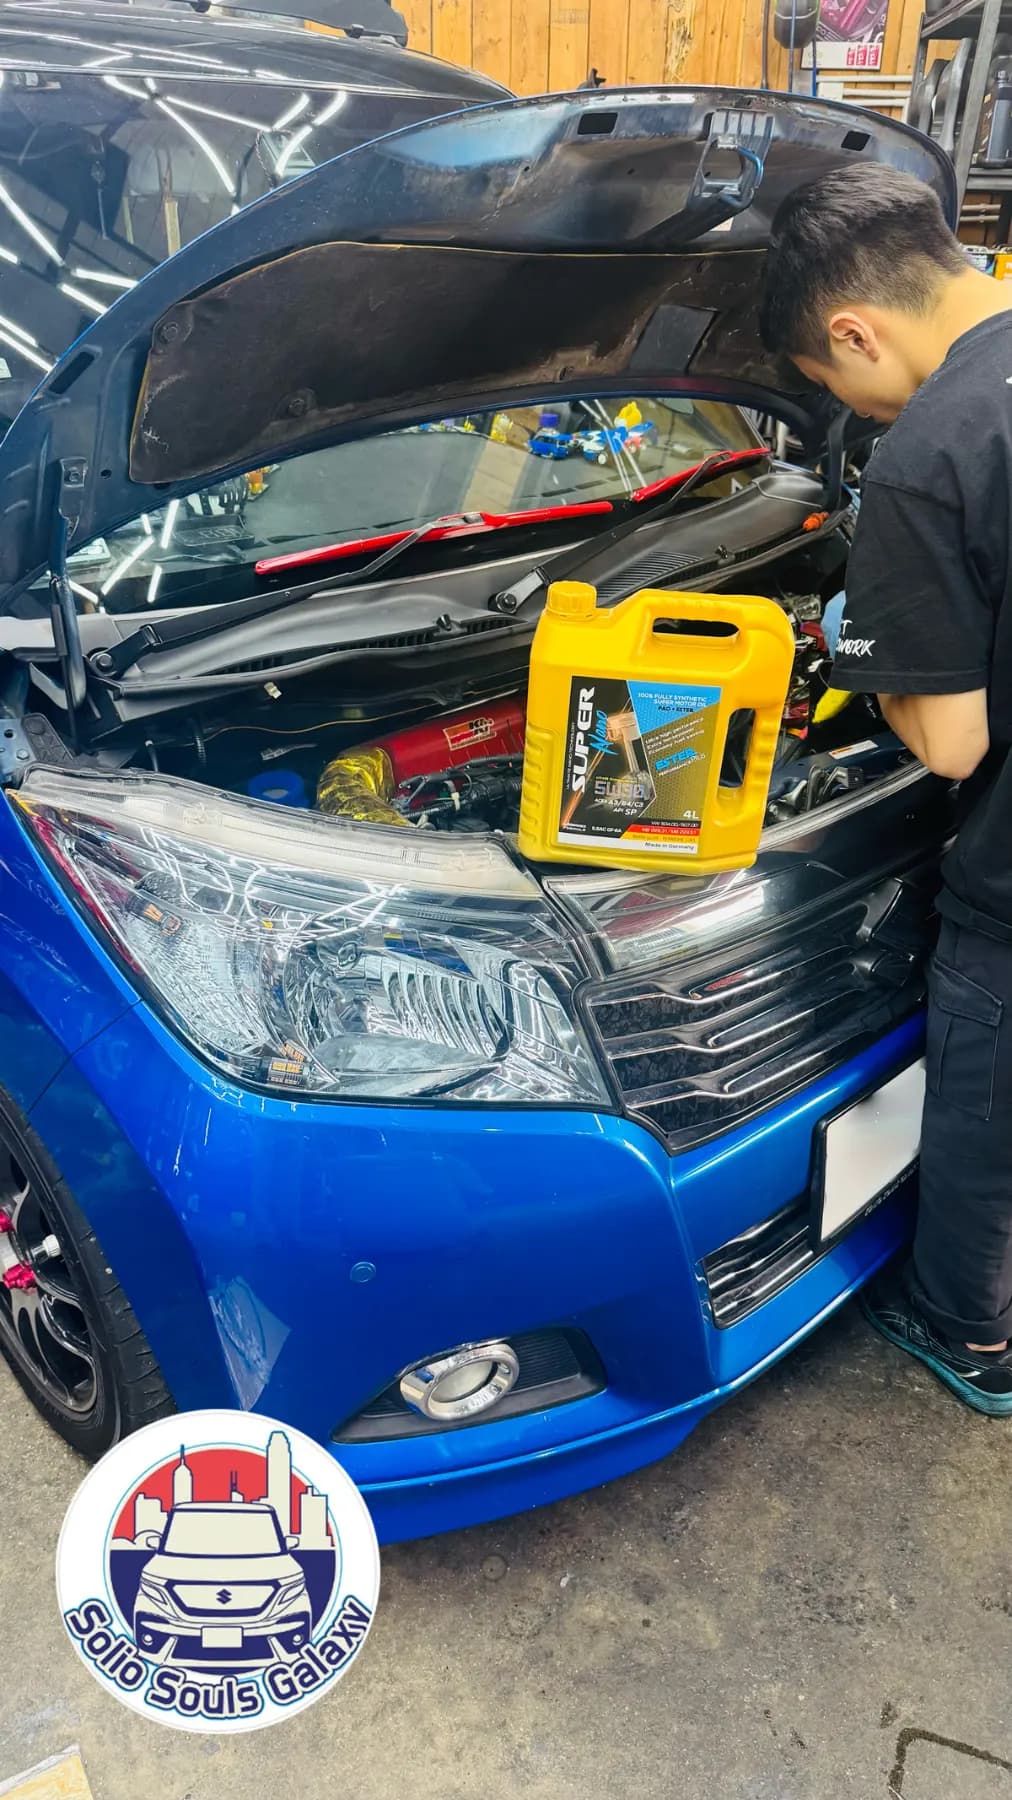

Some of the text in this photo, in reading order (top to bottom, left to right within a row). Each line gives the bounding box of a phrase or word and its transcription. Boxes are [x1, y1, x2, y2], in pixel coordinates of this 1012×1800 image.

[673, 695, 707, 703] SYNTHETIC
[588, 709, 620, 756] Nano
[572, 686, 595, 794] SUPER
[654, 746, 697, 772] ESTER
[608, 799, 644, 808] A3/B4/C3
[624, 808, 638, 816] SP
[683, 809, 700, 819] 4L
